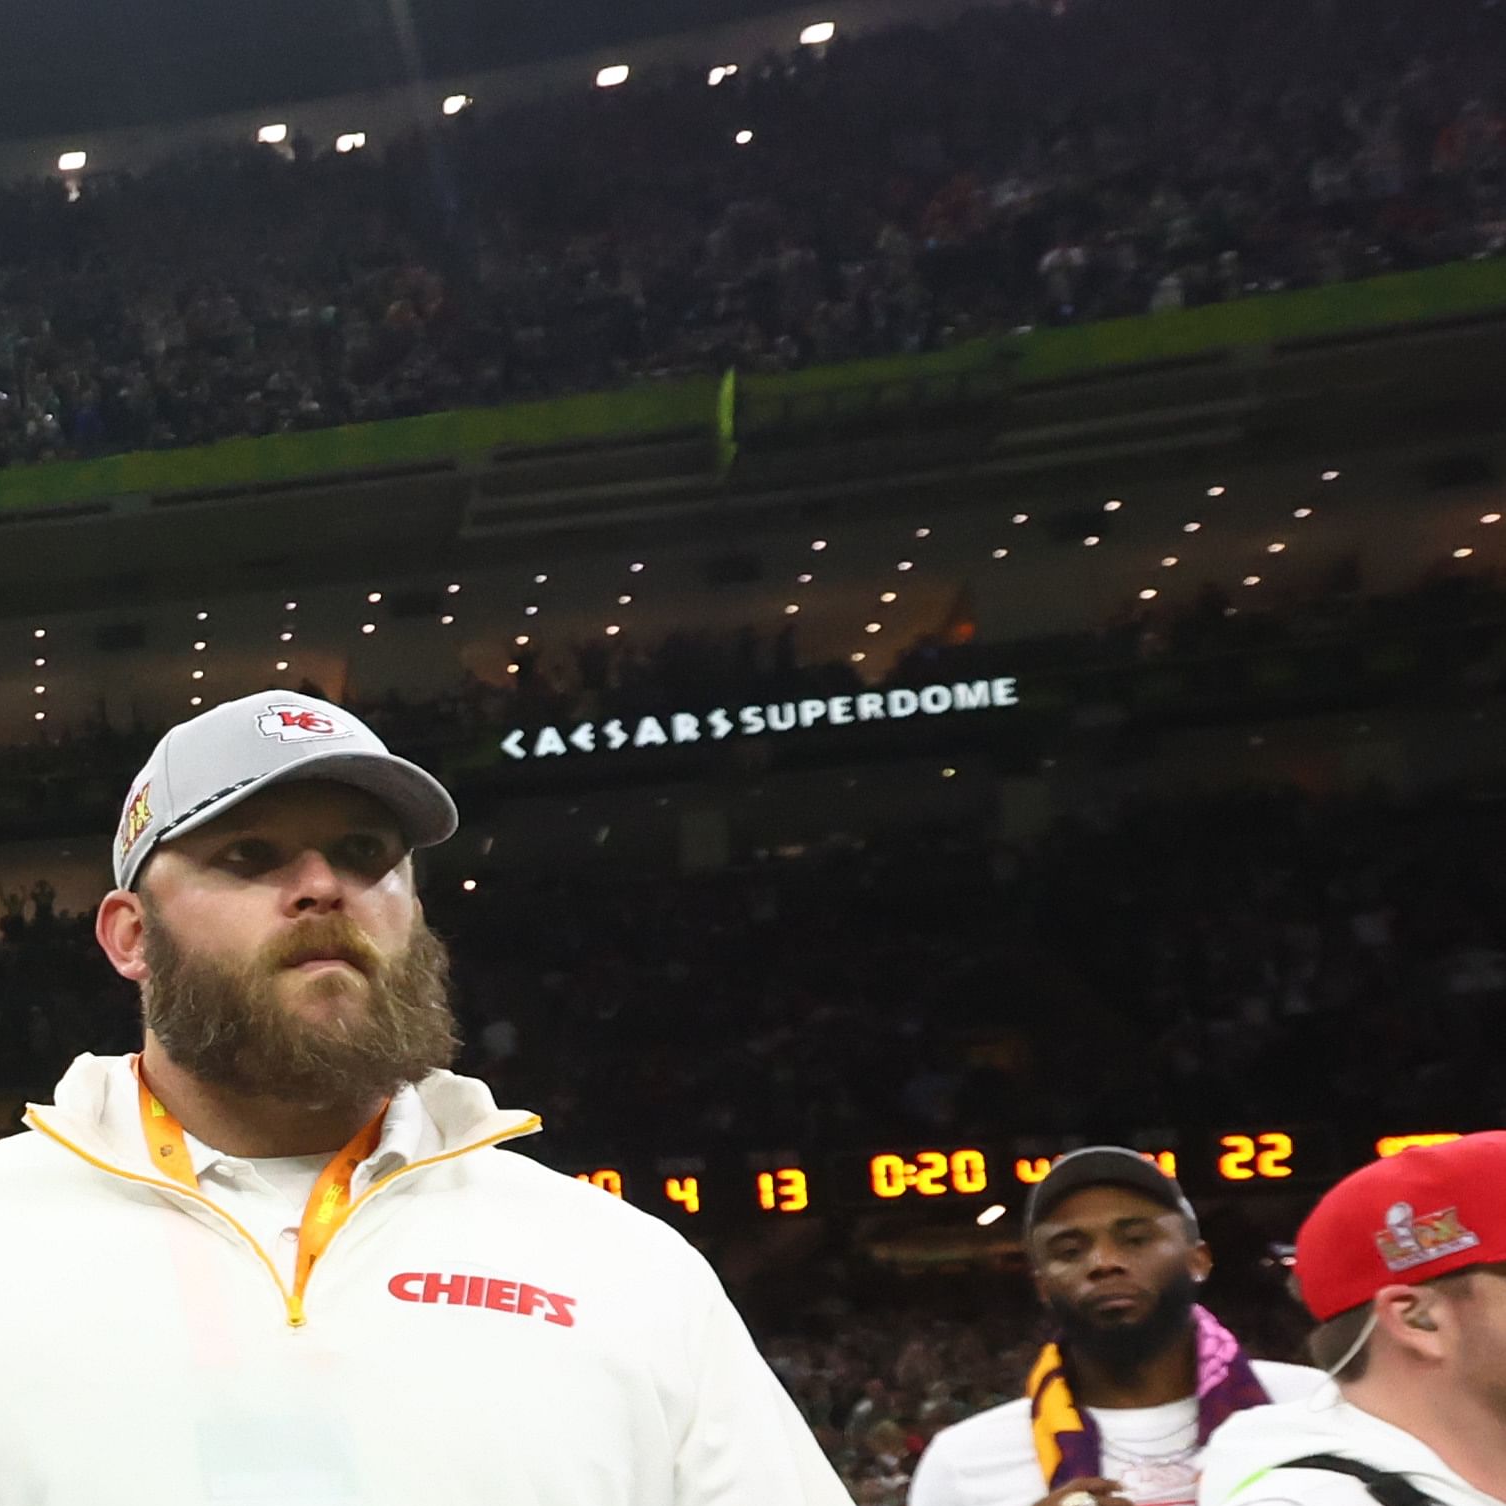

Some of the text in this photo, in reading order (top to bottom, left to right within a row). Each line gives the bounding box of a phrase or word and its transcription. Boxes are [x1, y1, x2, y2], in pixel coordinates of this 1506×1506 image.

[501, 675, 1020, 760] CAESARS SUPERDOME
[664, 1175, 700, 1214] 4
[756, 1167, 809, 1212] 13
[870, 1148, 988, 1199] 0:20
[1218, 1131, 1294, 1181] 22
[388, 1271, 578, 1329] CHIEFS
